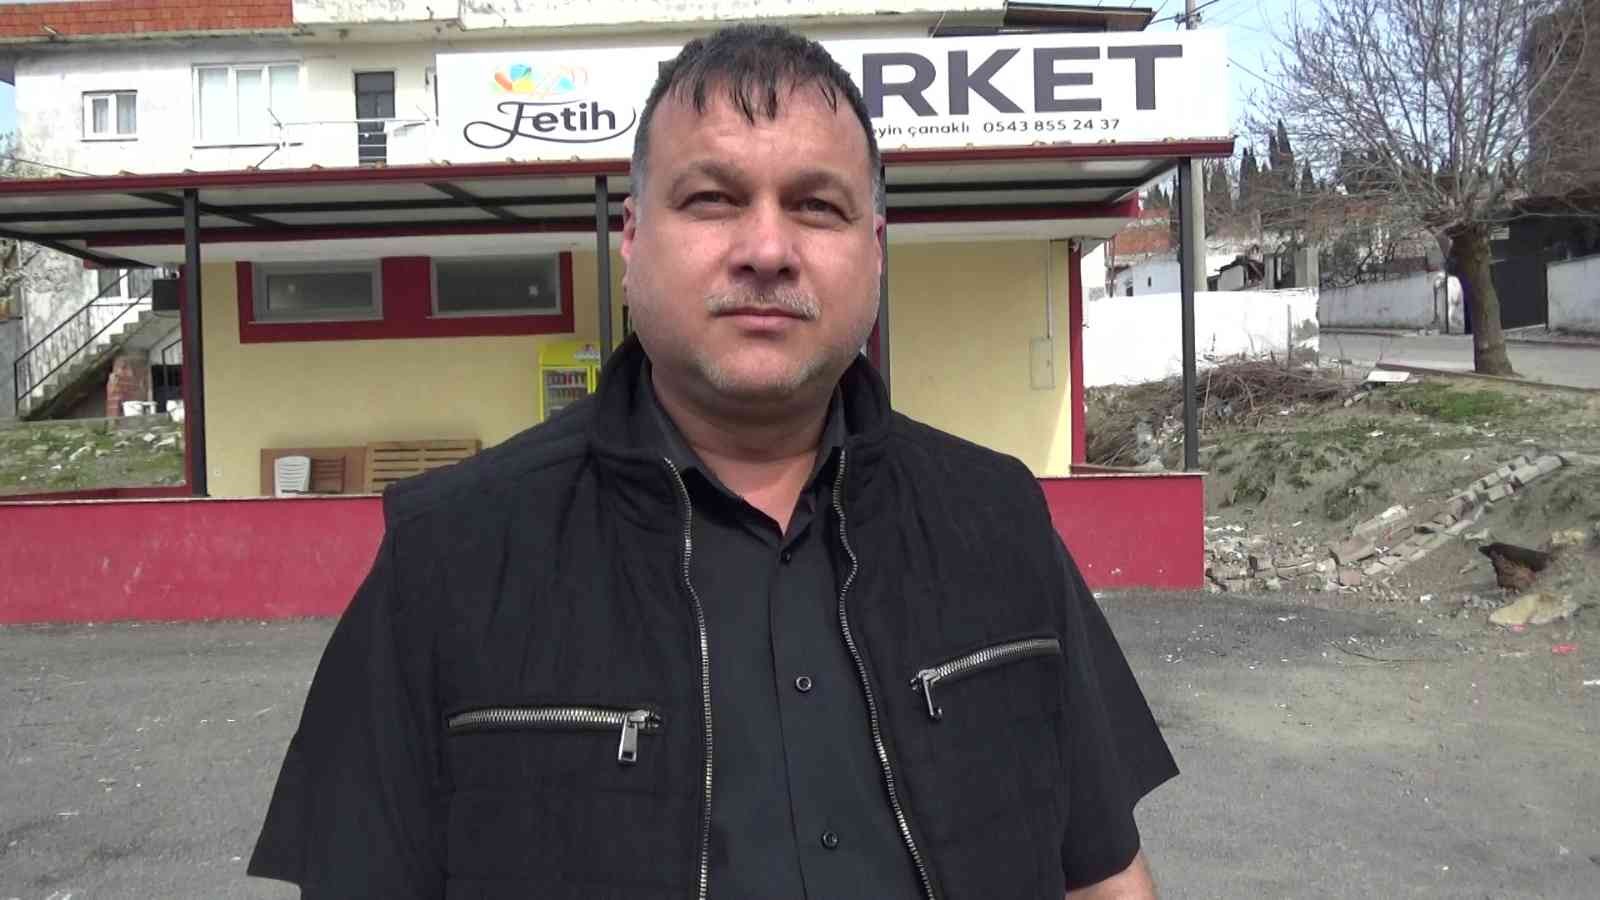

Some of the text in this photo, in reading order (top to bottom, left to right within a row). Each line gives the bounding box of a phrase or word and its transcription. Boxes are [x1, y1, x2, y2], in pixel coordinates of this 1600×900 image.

[463, 44, 1184, 149] Fetih RKET
[907, 121, 970, 137] çanaklı
[983, 120, 1028, 133] 0543
[1034, 119, 1067, 132] 855
[1073, 119, 1094, 131] 24
[1100, 118, 1120, 130] 37
